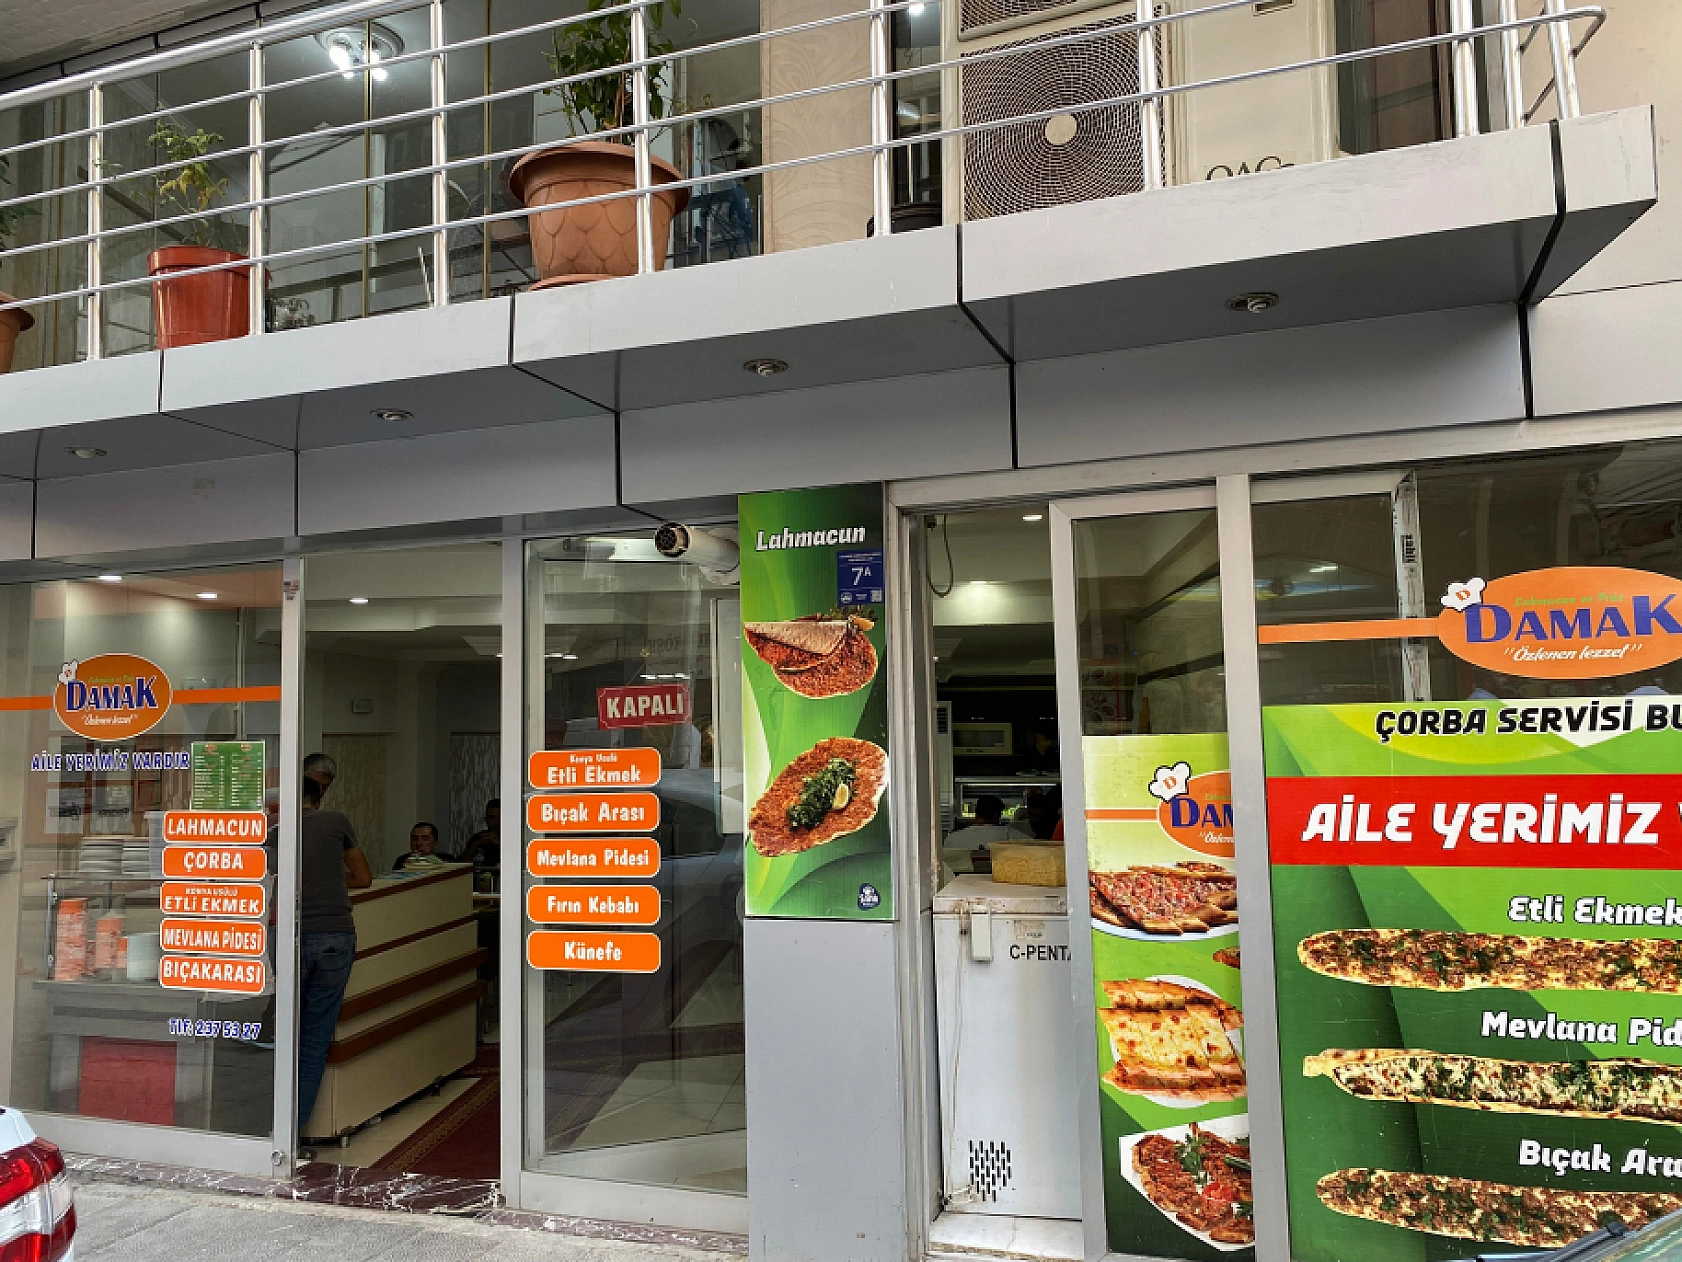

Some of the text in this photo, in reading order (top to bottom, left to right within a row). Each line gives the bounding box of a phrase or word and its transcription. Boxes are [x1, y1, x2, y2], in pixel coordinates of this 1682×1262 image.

[756, 526, 866, 551] Lahmacun
[1465, 593, 1682, 643] DAMAK
[66, 676, 158, 712] DAMAK
[606, 693, 684, 719] KAPALI
[1375, 706, 1488, 744] ÇORBA
[1496, 698, 1634, 735] SERVİSİ
[31, 748, 190, 772] AİLE YERİMİZ VARDIR
[547, 765, 641, 784] Etli Ekmek
[541, 802, 644, 826] Bıçak Arası
[1300, 794, 1416, 843] AİLE
[1432, 793, 1662, 850] YERİMİZ
[168, 818, 262, 836] LAHMACUN
[183, 851, 244, 873] ÇORBA
[536, 848, 649, 867] Mevlana Pidesi
[164, 896, 260, 913] ETLİ EKMEK
[547, 895, 639, 914] Fırın Kebabı
[1508, 895, 1682, 926] Etli Ekmek
[163, 926, 262, 950] MEVLANA PİDESİ
[564, 940, 622, 961] Künefe
[163, 959, 261, 984] BIÇAKARASI
[195, 1020, 221, 1038] 237
[222, 1021, 240, 1038] 53
[242, 1022, 261, 1039] 27
[1480, 1010, 1618, 1044] Mevlana
[1518, 1138, 1611, 1177] Bıçak
